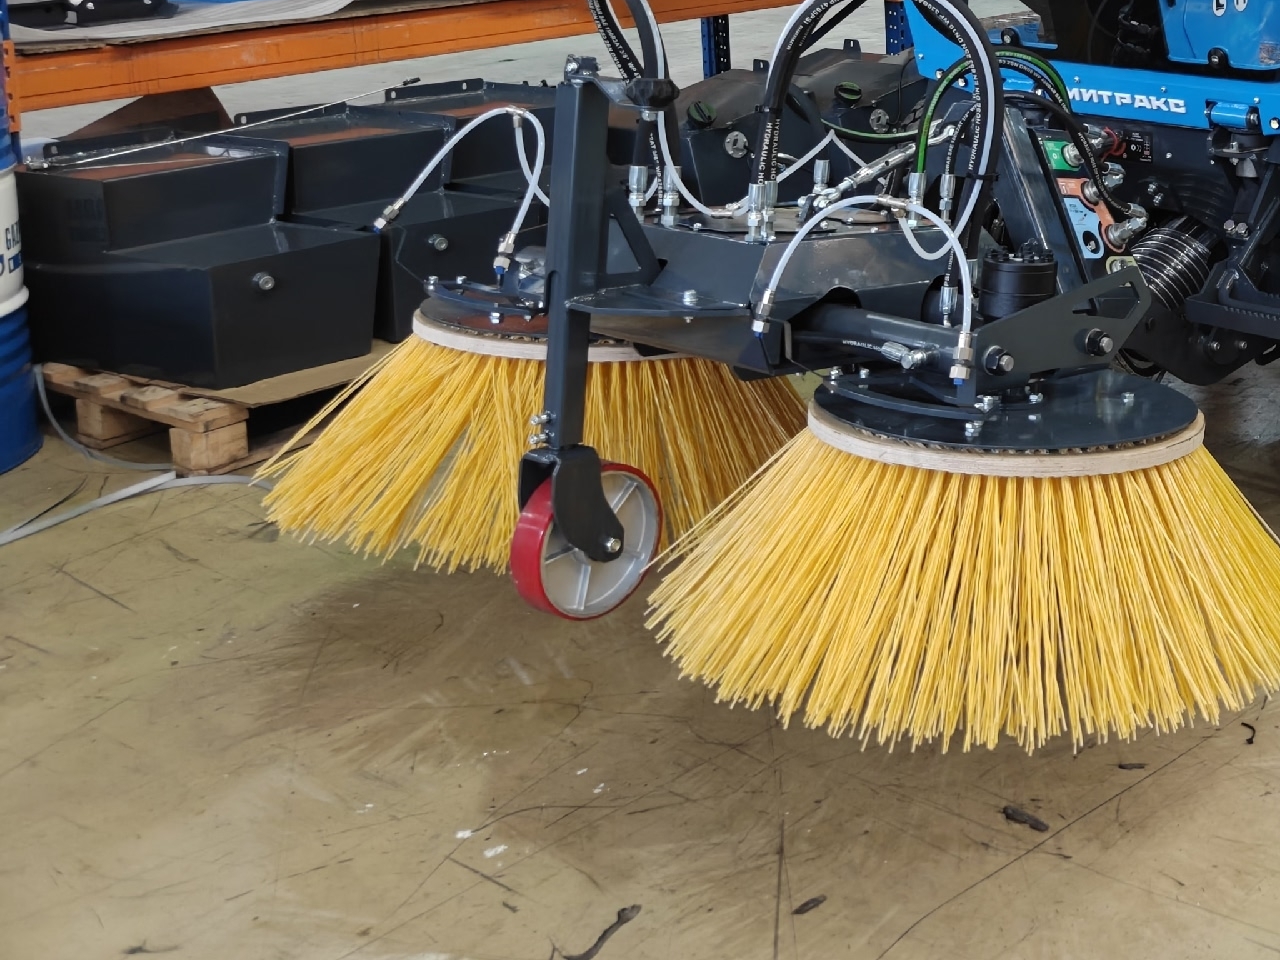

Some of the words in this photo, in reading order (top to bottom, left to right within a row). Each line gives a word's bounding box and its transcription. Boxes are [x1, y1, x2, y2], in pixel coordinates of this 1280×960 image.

[1066, 87, 1187, 114] МИТРАКС
[758, 122, 774, 171] HYDRAULIC
[770, 118, 781, 167] HYDRAULIC
